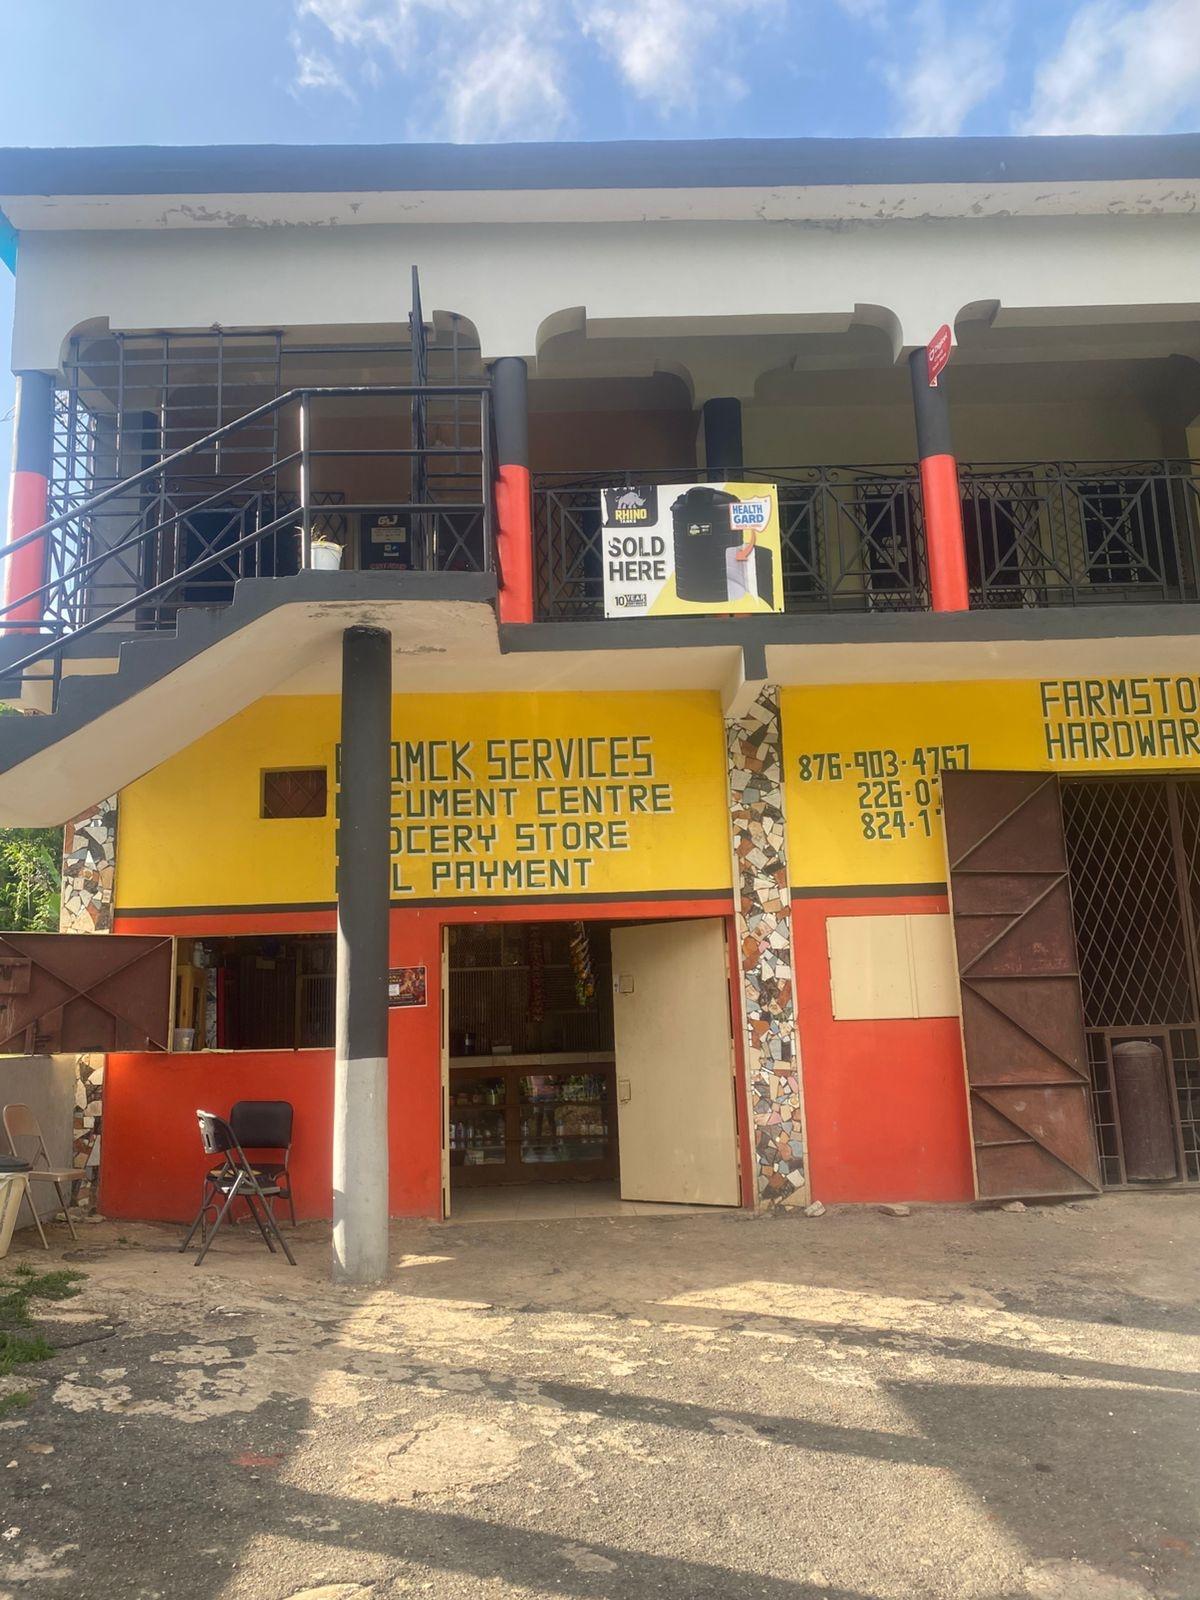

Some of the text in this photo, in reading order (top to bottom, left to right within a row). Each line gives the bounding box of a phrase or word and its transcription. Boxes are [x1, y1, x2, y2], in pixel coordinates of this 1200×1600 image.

[614, 508, 648, 520] RHINO
[732, 504, 763, 514] HEALTH
[733, 514, 764, 524] GARD
[608, 535, 665, 558] SOLD
[608, 560, 666, 581] HERE
[615, 596, 625, 607] 10
[1040, 677, 1200, 718] FARMSTO
[487, 736, 653, 781] SERVICES
[536, 783, 673, 816] CENTRE
[515, 820, 629, 852] STORE
[432, 857, 593, 891] PAYMENT
